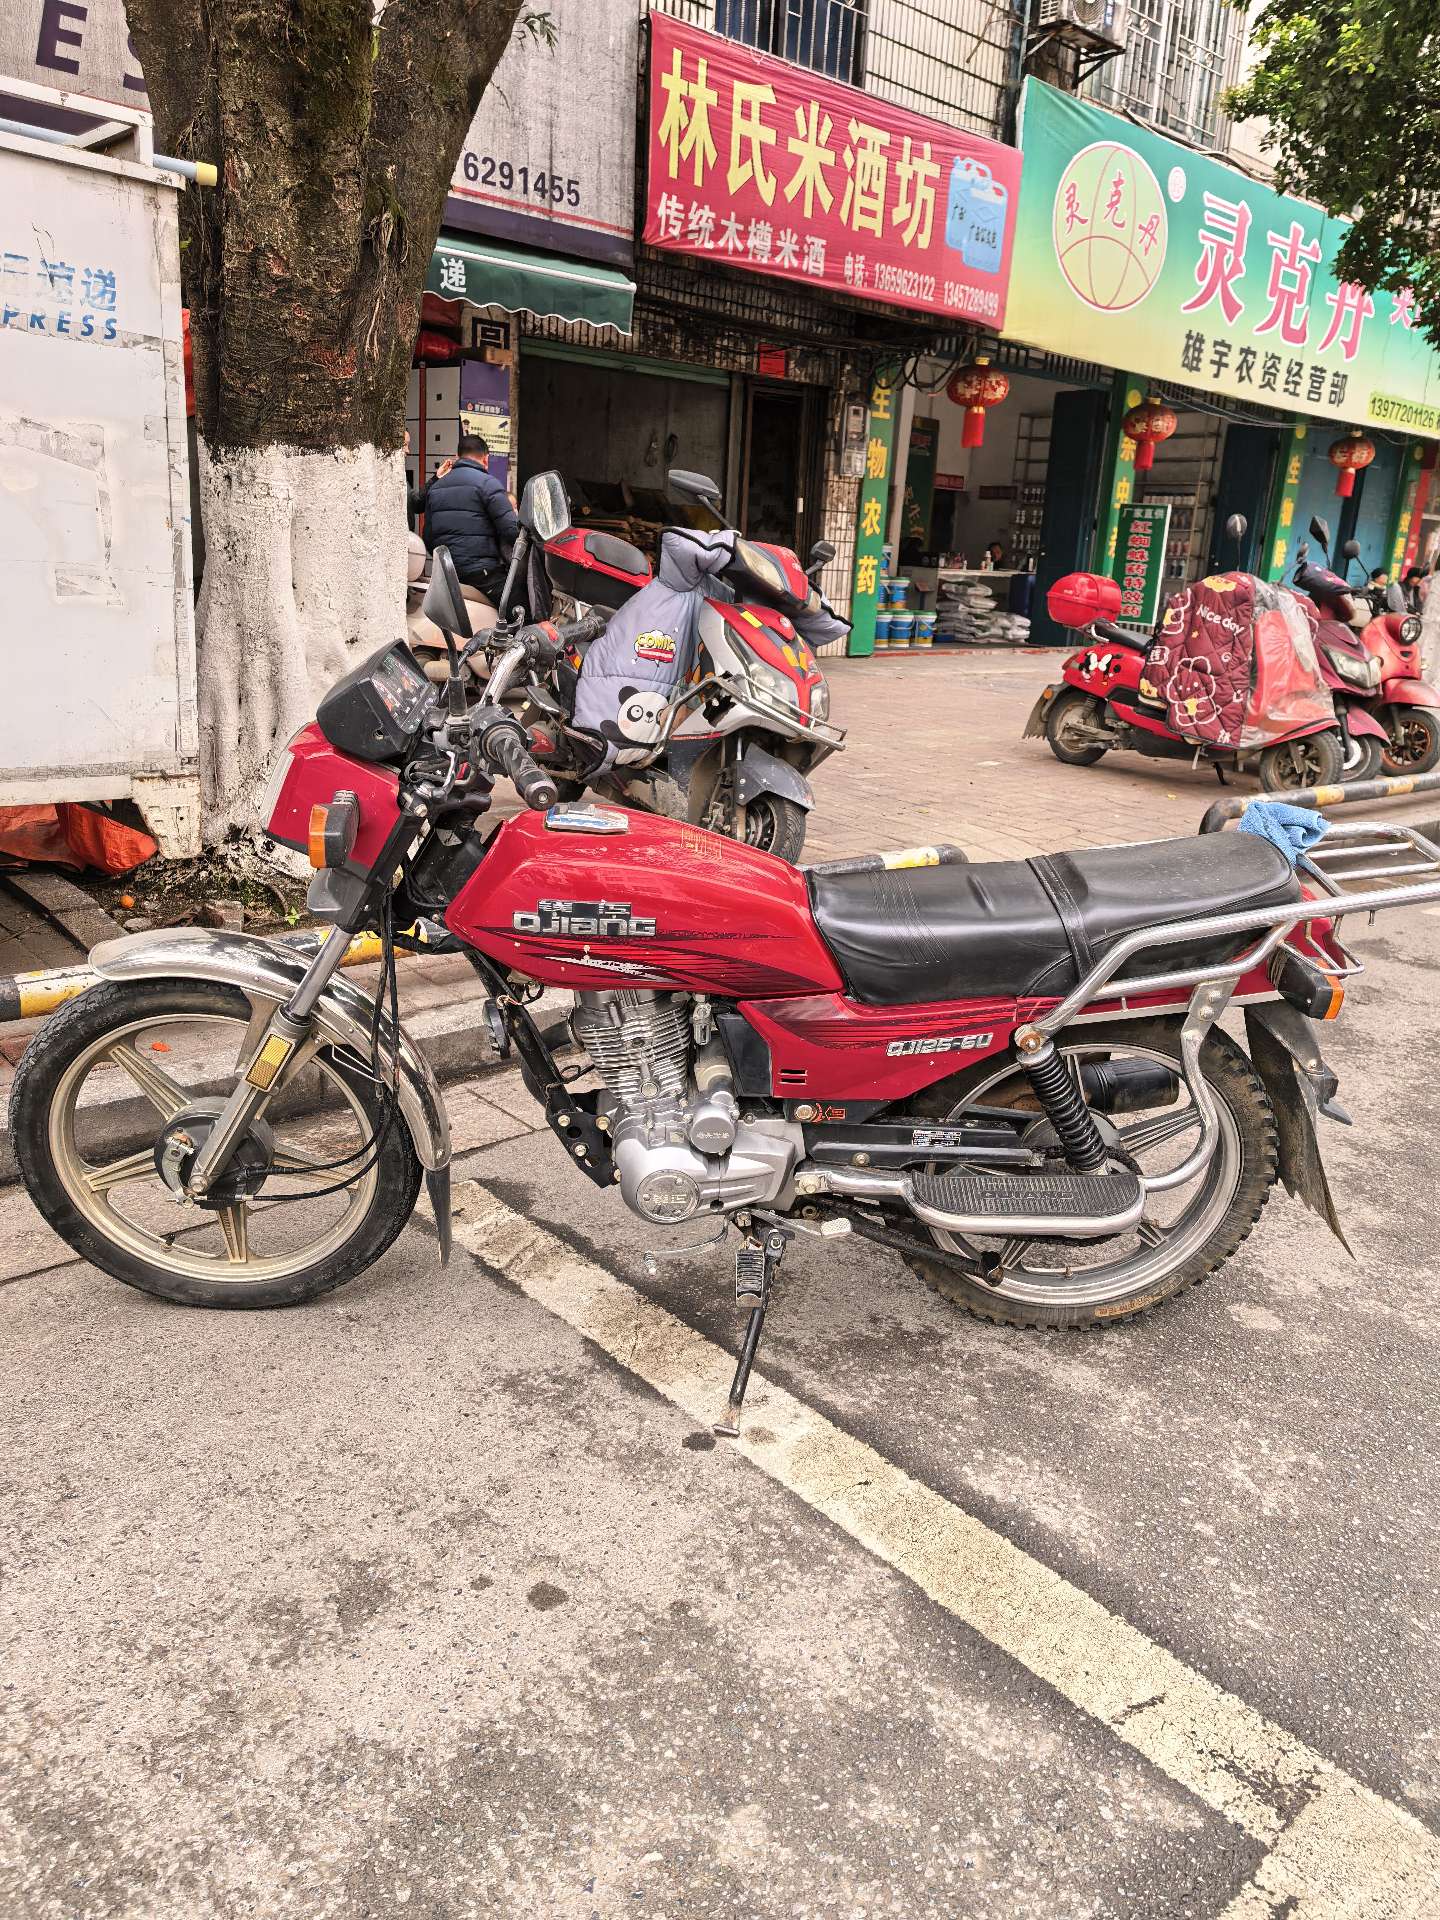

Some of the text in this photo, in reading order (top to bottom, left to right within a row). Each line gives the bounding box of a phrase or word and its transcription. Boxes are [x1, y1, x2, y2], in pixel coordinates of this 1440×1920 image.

[463, 152, 580, 207] 6291455
[657, 47, 942, 249] 林氏米酒坊
[657, 192, 828, 277] 传统木樽米酒
[1181, 191, 1375, 363] 灵克丹
[1181, 329, 1349, 408] 雄宇农资经营部
[1370, 397, 1435, 428] 13977201126
[856, 379, 891, 596] 生物农药
[1196, 604, 1246, 636] Nice day
